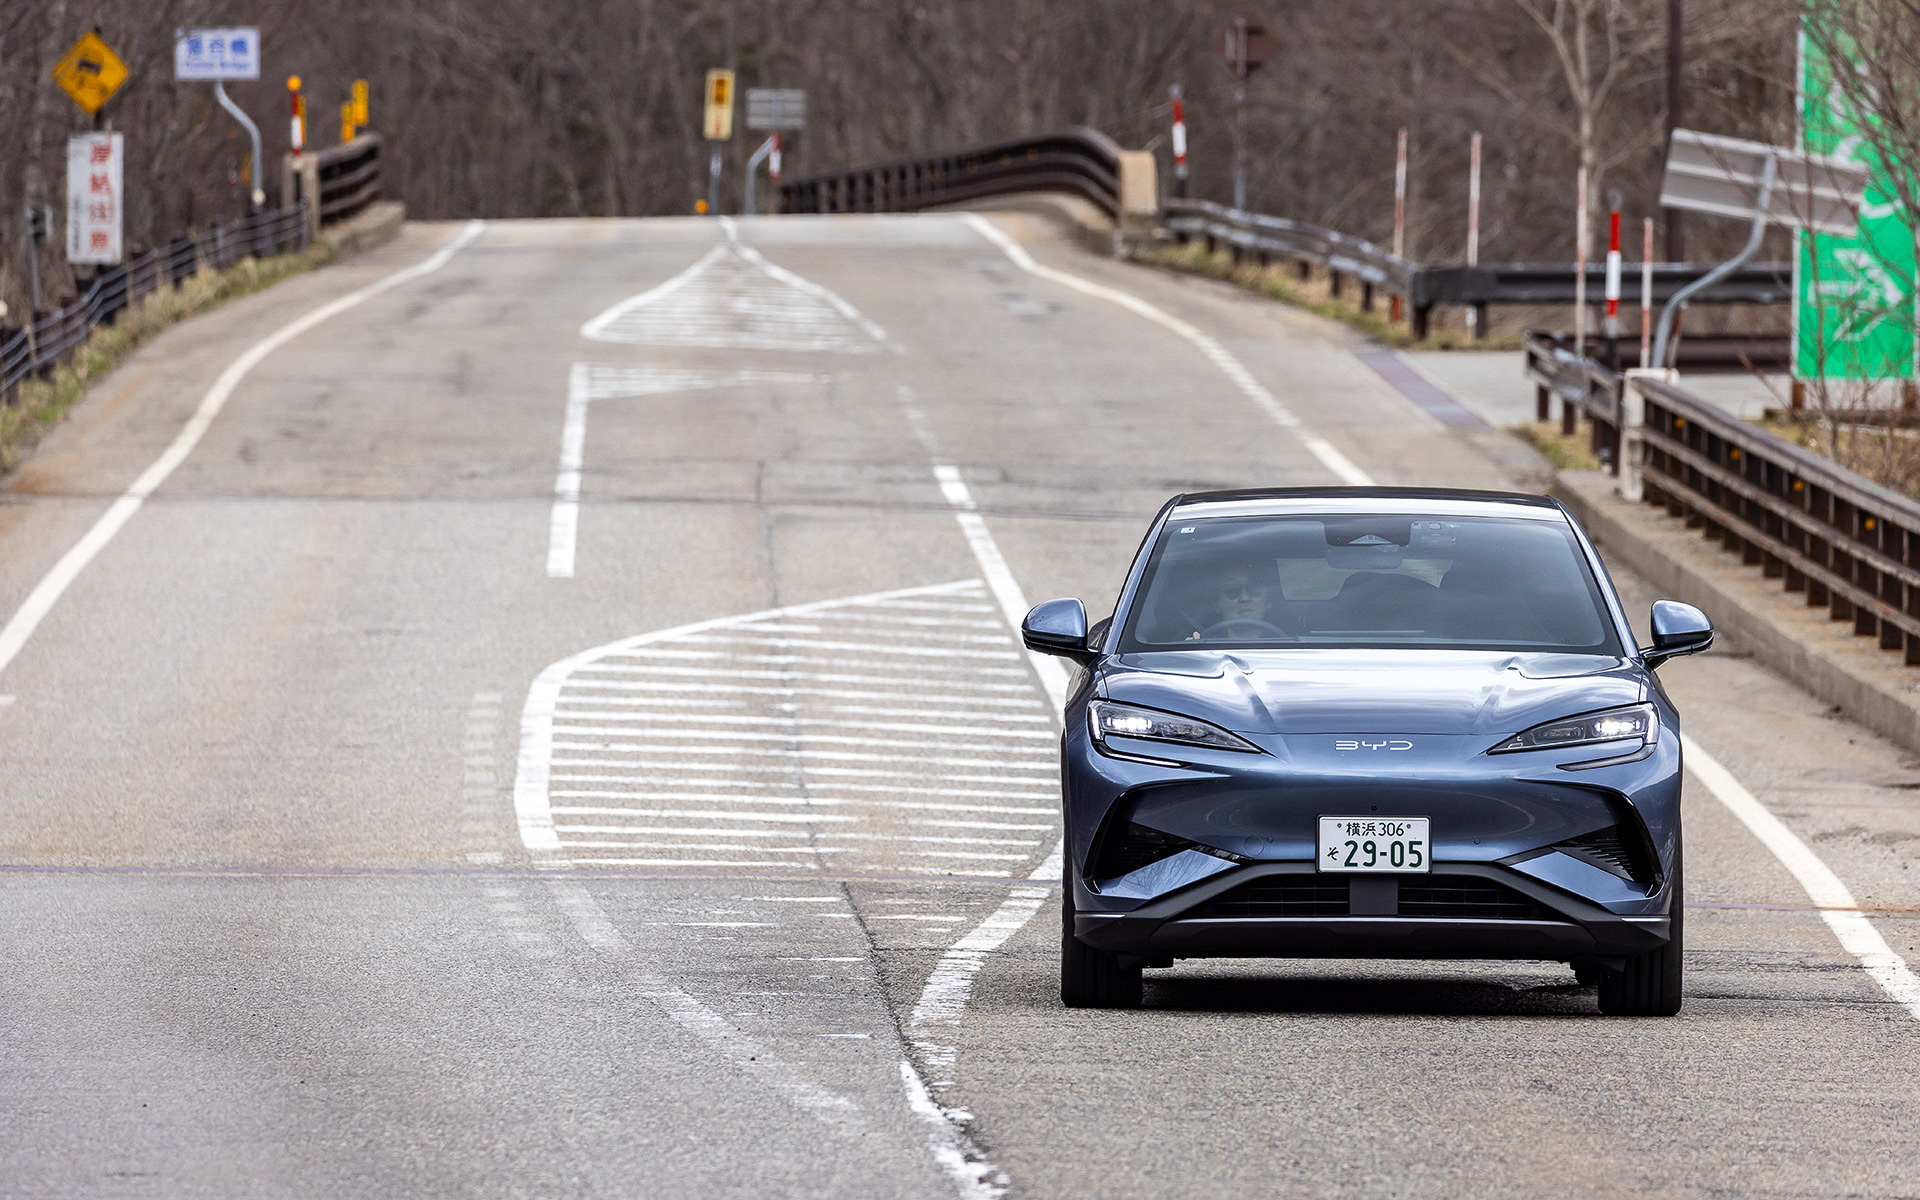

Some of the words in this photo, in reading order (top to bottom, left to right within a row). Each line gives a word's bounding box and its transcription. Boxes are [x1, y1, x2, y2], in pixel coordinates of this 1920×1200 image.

[1335, 740, 1413, 751] BYD
[1327, 846, 1339, 861] そ
[1344, 840, 1423, 867] 29-05
